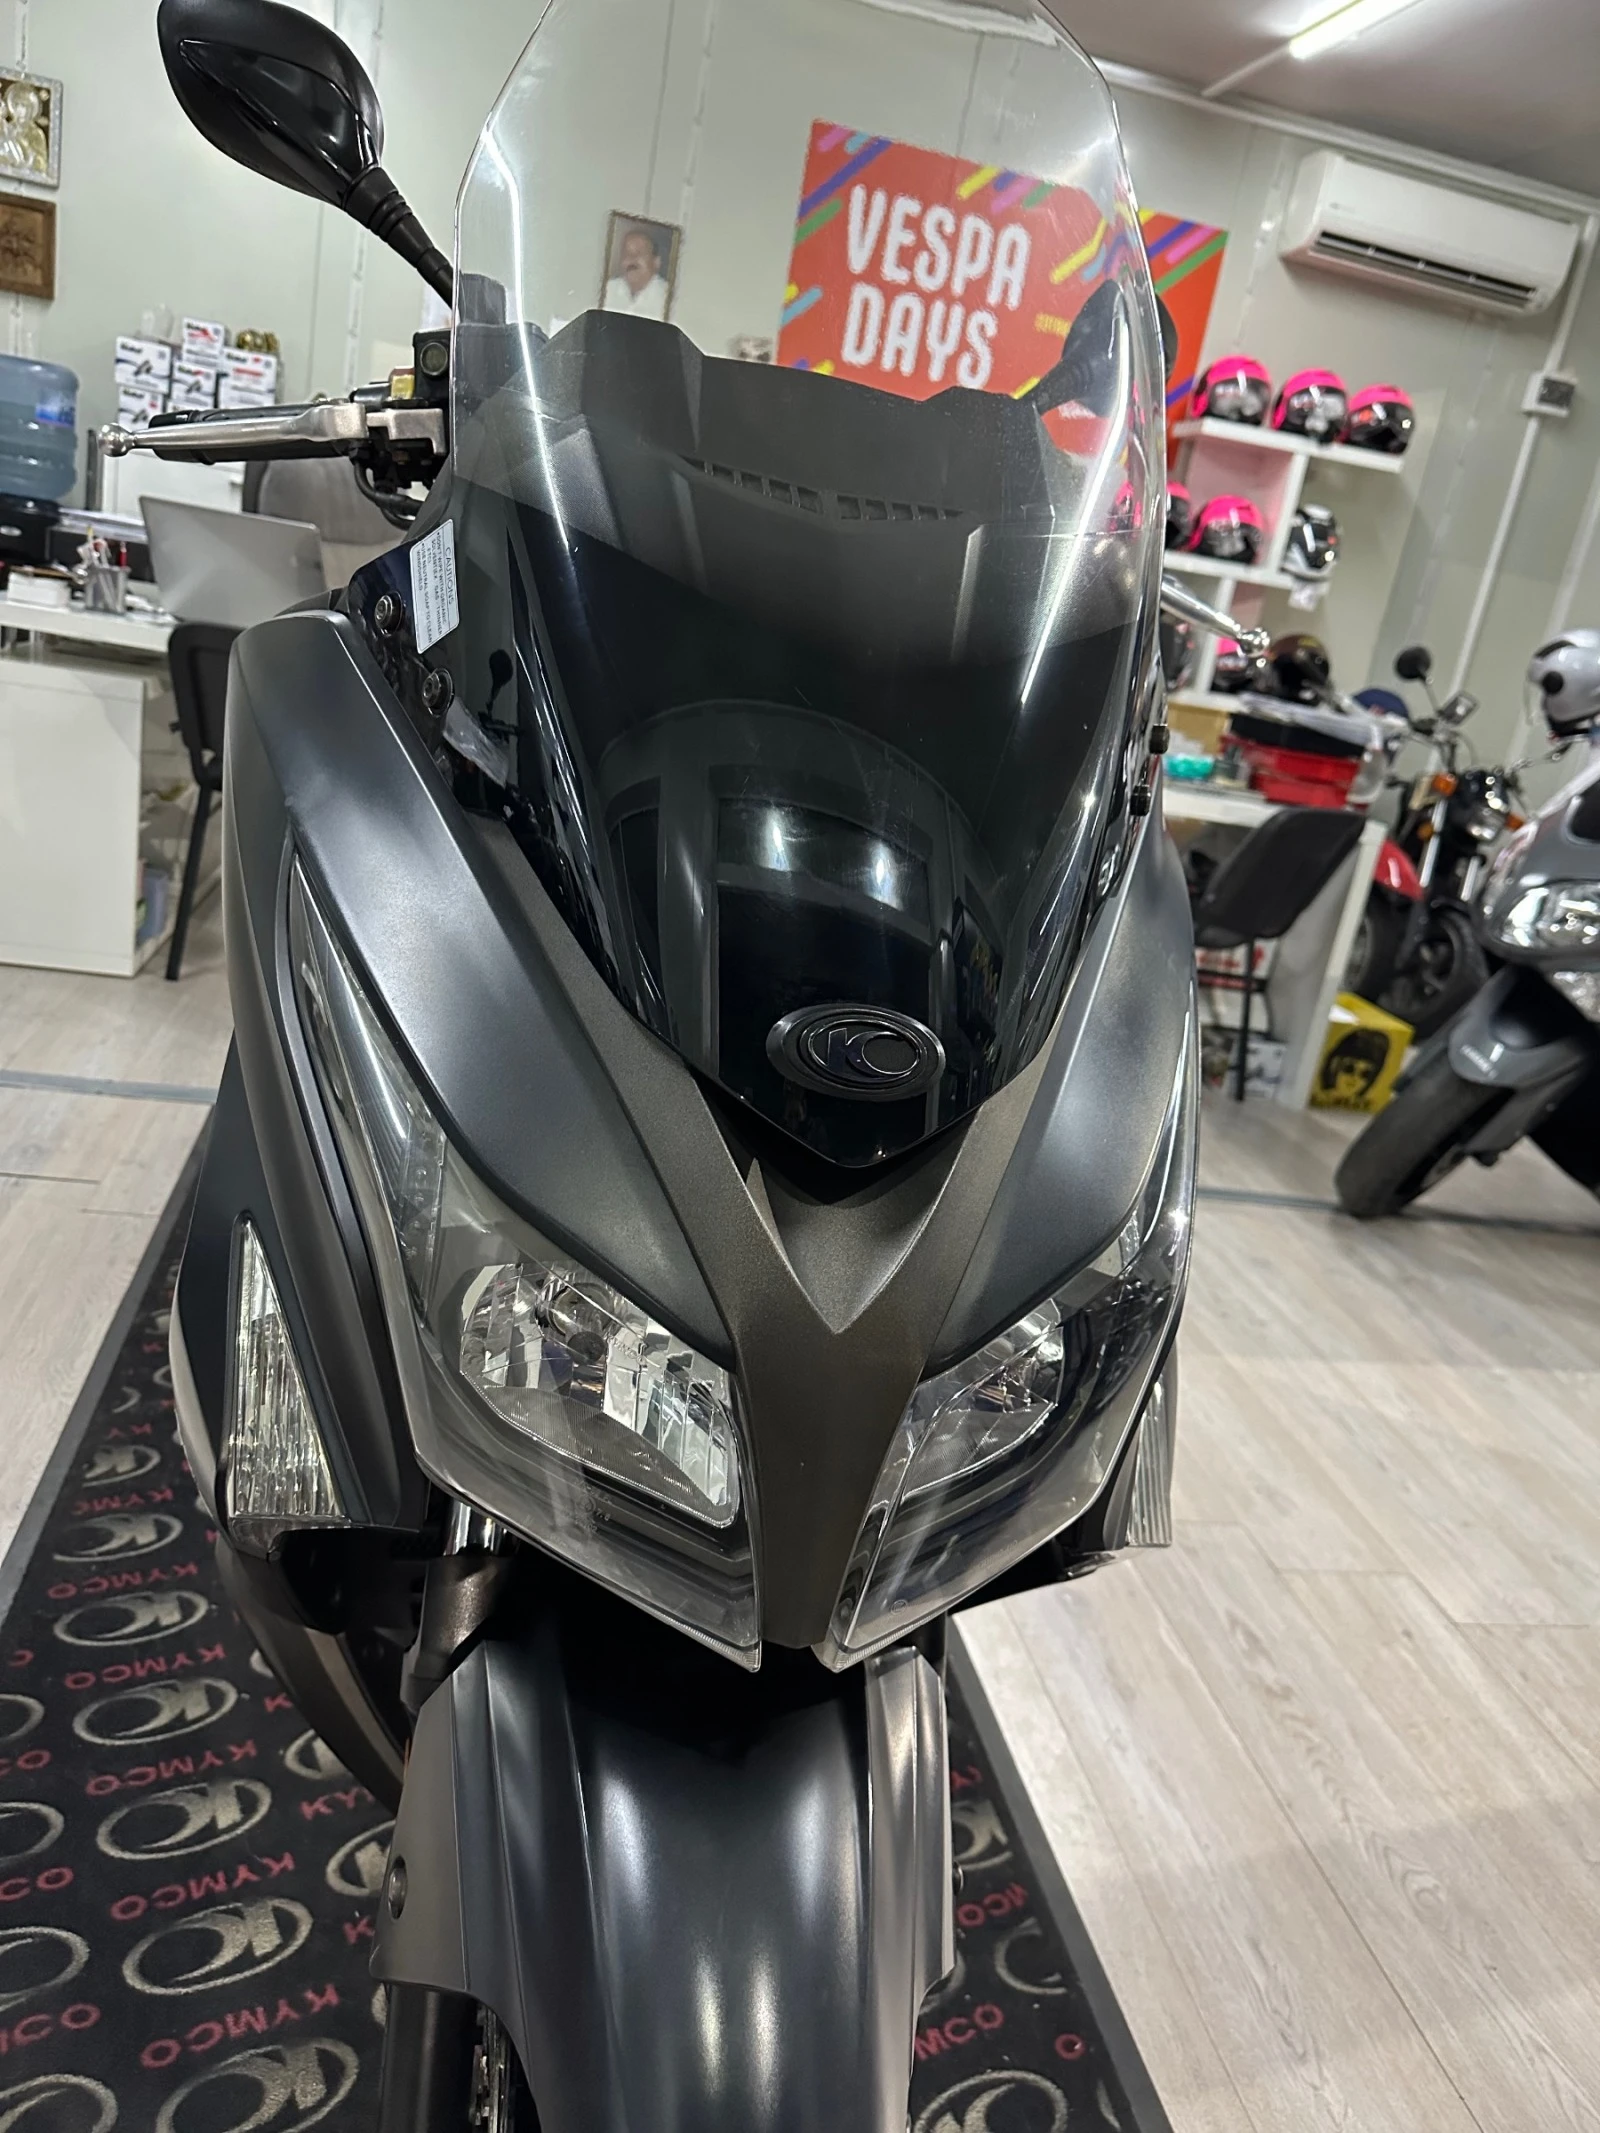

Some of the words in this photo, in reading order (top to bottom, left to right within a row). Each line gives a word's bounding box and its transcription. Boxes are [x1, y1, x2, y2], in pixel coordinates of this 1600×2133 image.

[847, 183, 1032, 311] VESPA
[840, 281, 999, 390] DAYS
[445, 547, 455, 605] CAUTIONS
[49, 1564, 197, 1596] KYMCO
[66, 1644, 226, 1688] KYMCO
[88, 1741, 256, 1793] KYMCO
[111, 1853, 294, 1920] KYMCO
[142, 1985, 339, 2068] KYMCO
